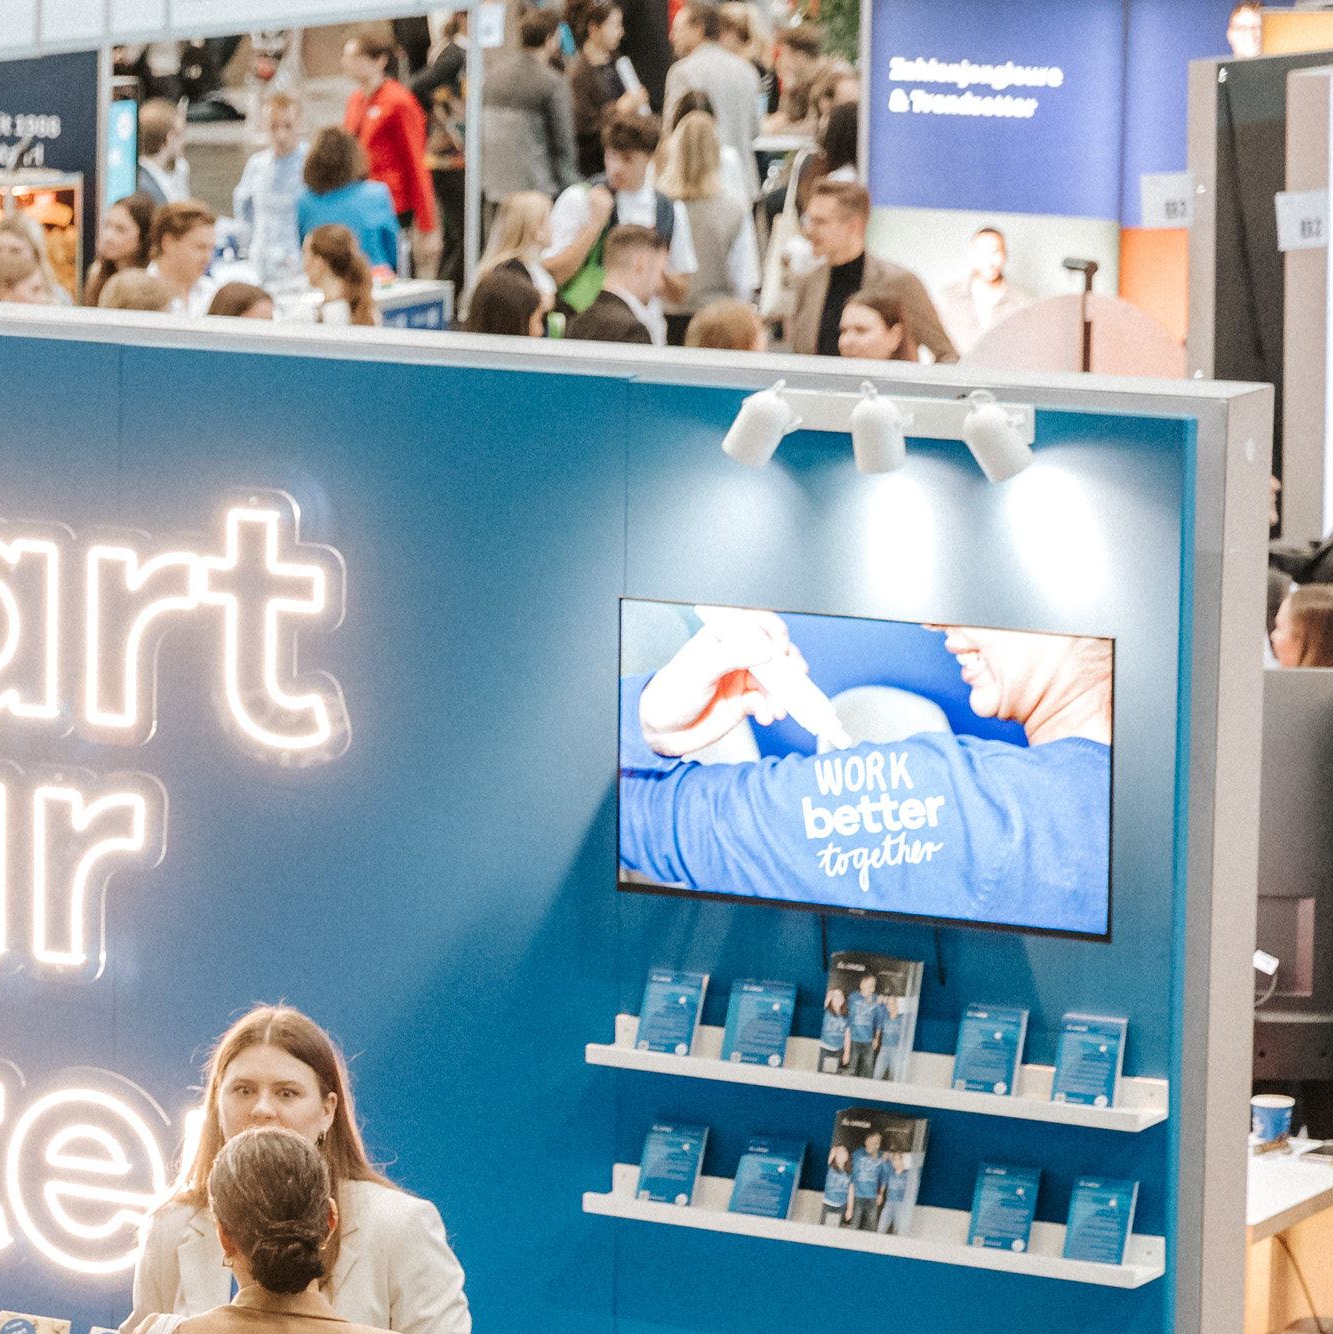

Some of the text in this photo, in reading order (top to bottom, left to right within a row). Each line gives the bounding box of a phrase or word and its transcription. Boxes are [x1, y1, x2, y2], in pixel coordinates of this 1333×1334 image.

[888, 87, 1039, 118] & Trendsetter
[814, 750, 915, 797] WORK
[801, 793, 945, 840] better
[816, 831, 944, 893] together
